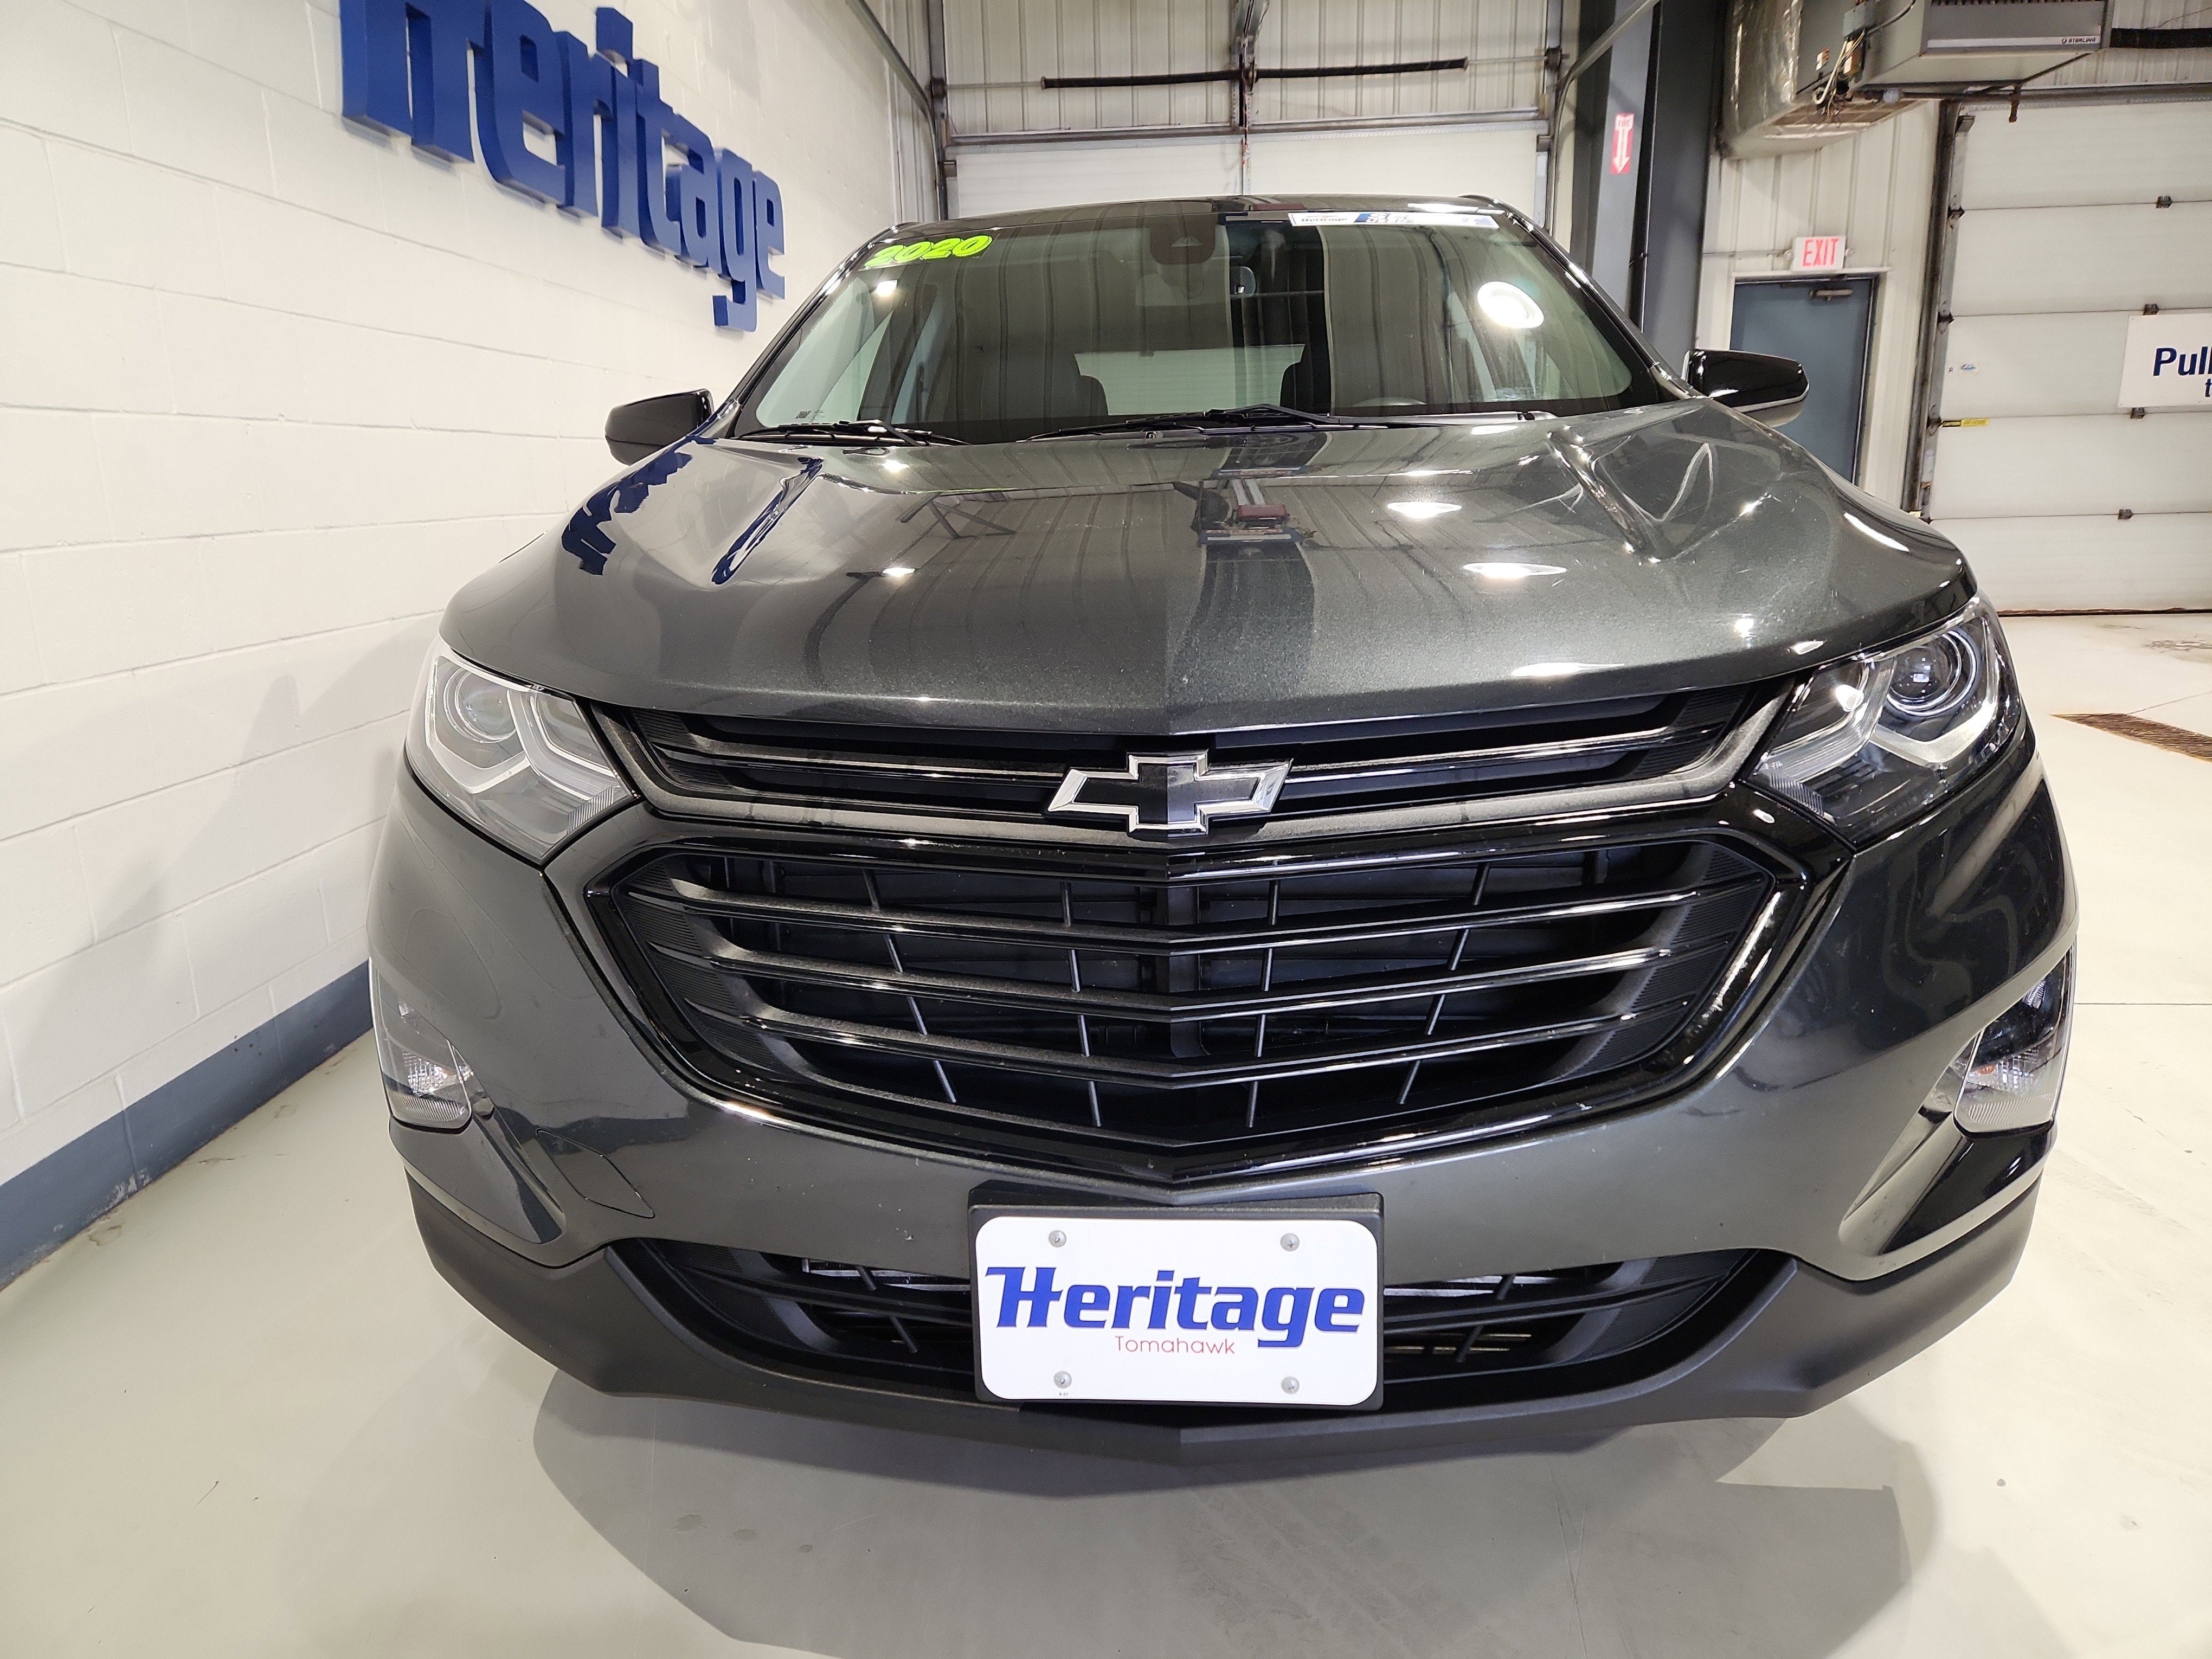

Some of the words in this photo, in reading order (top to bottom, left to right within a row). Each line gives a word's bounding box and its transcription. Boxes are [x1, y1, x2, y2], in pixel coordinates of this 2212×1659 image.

[864, 235, 993, 268] 2020
[1803, 239, 1838, 267] EXIT
[986, 1266, 1365, 1348] Heritage
[1115, 1335, 1235, 1354] Tomahawk
